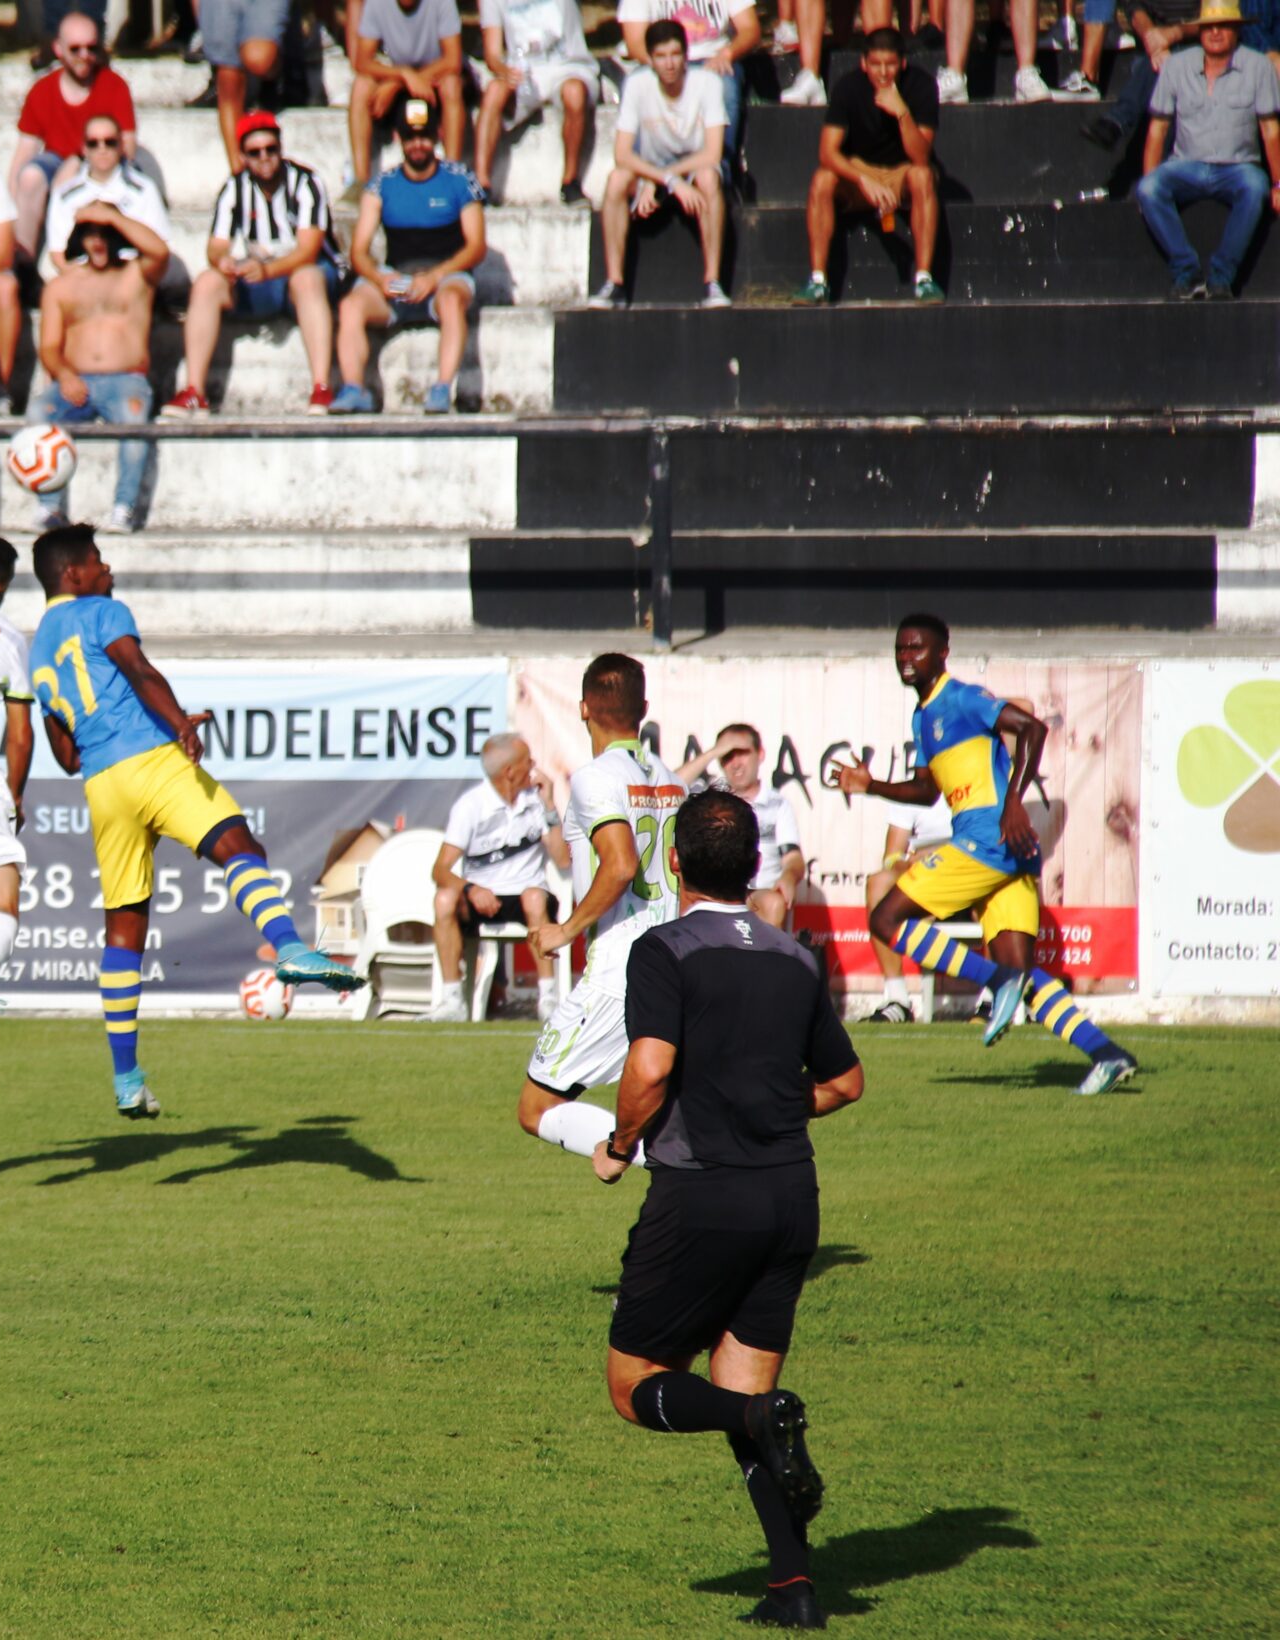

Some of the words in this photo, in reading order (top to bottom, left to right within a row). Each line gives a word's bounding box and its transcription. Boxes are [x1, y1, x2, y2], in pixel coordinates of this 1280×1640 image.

[203, 706, 492, 758] NDELENSE
[35, 805, 89, 834] SEU
[18, 863, 74, 912] 38
[201, 868, 295, 914] 52
[1197, 896, 1273, 917] Morada:
[1061, 924, 1092, 943] 700
[1061, 946, 1092, 965] 424
[1168, 941, 1260, 961] Contacto:
